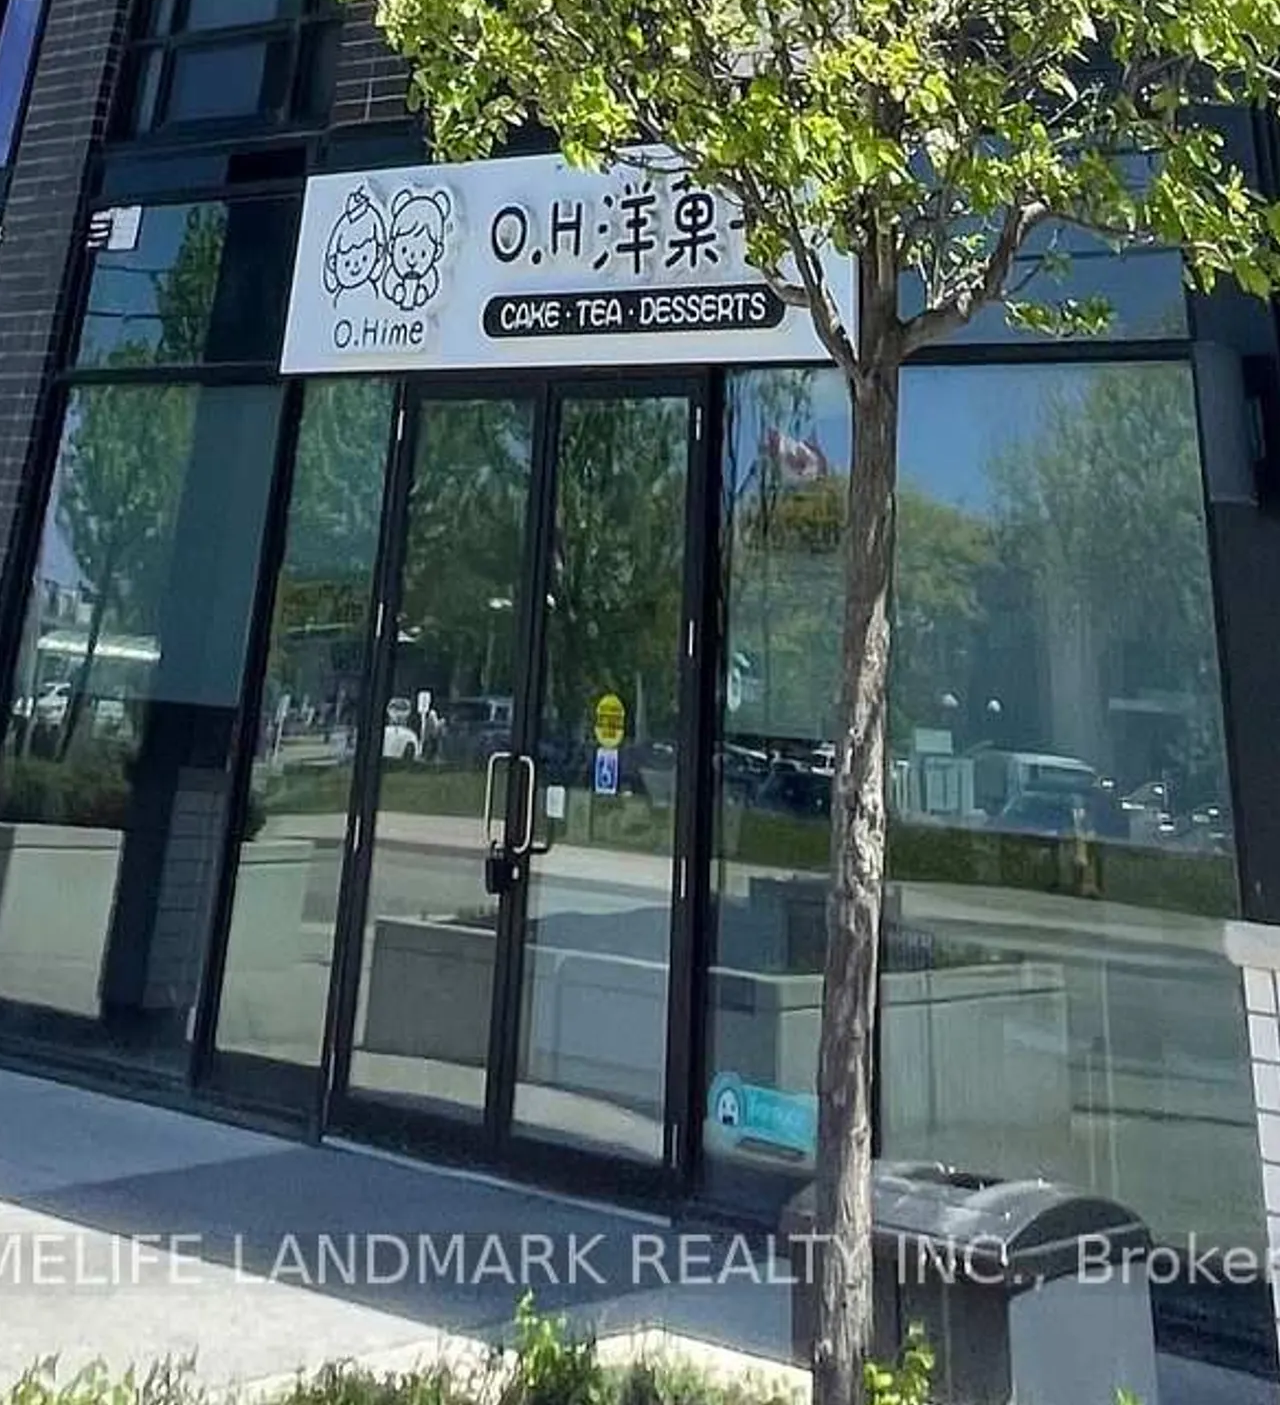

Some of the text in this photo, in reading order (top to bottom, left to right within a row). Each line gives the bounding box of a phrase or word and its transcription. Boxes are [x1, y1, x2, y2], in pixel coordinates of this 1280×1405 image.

[501, 291, 767, 329] CAKE TEA DESSERTS
[334, 316, 424, 348] O.Hime
